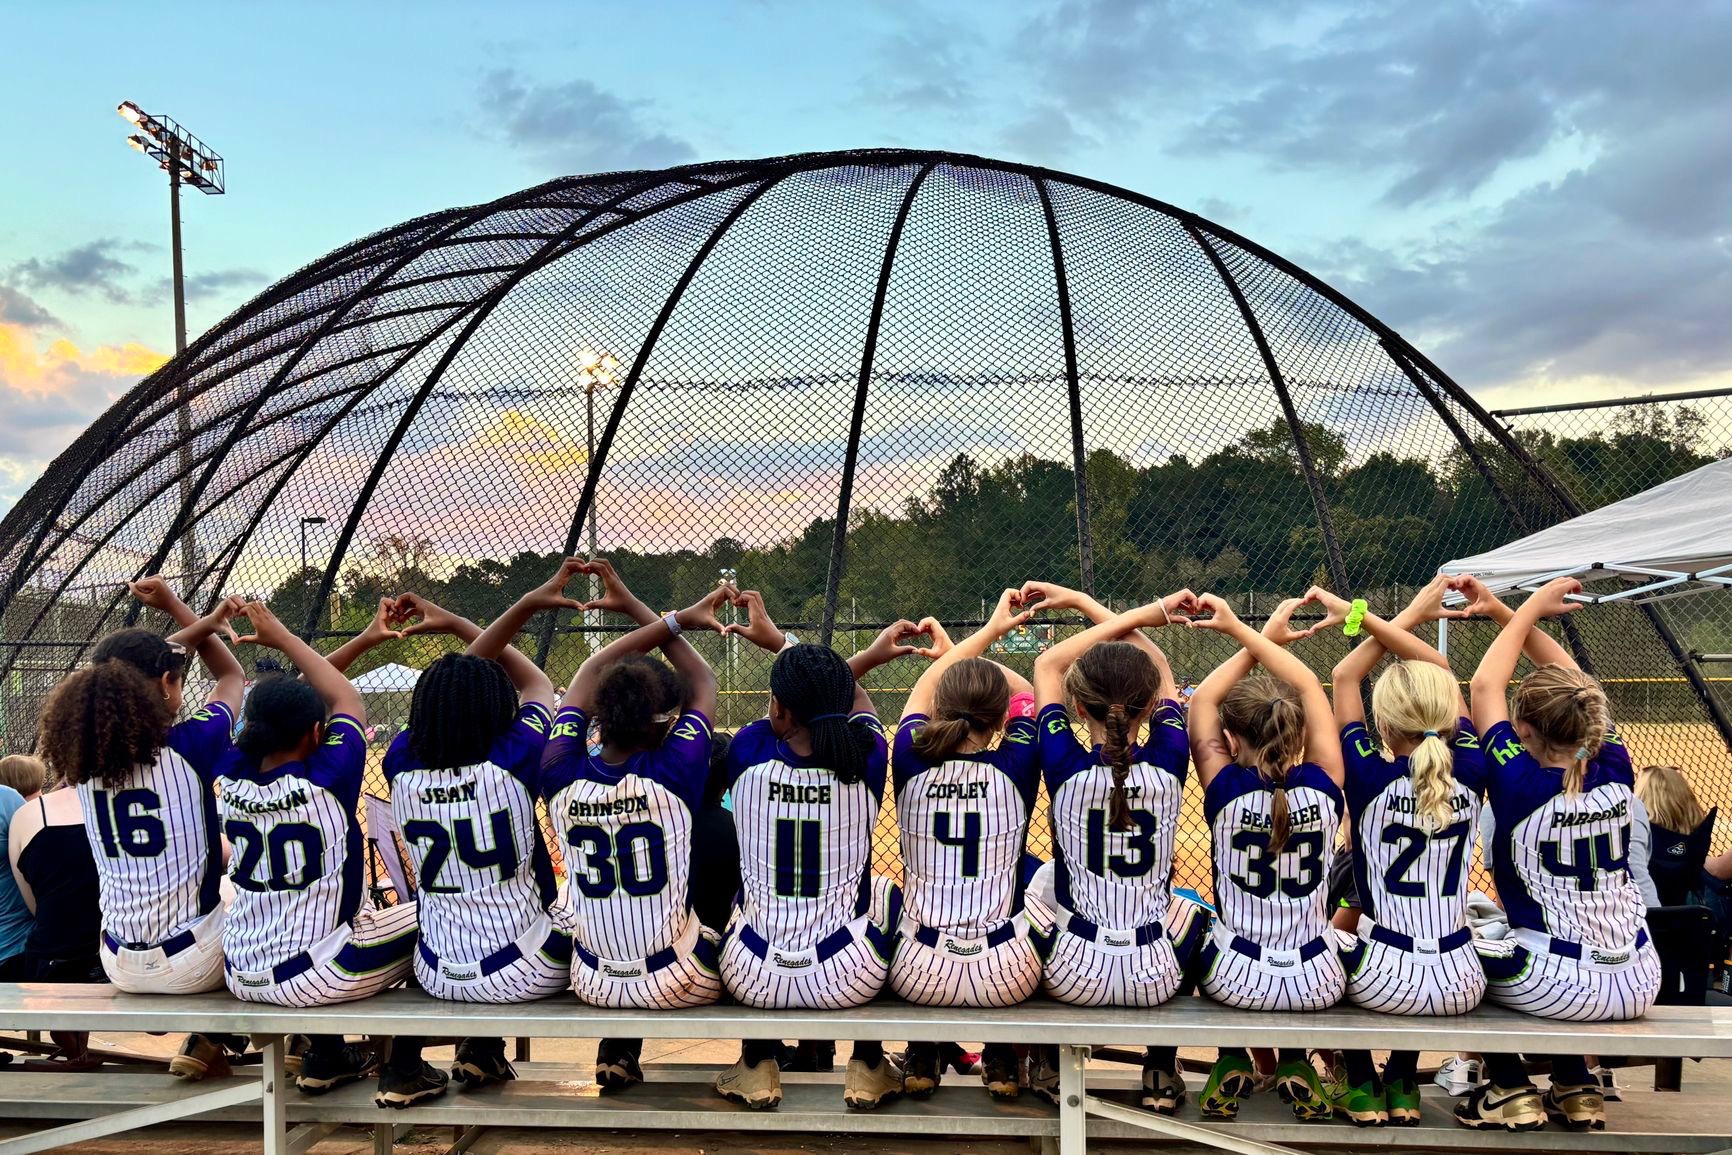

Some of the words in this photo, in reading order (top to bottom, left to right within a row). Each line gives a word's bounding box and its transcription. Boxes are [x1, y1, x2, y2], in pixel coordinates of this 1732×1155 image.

[421, 781, 476, 804] JEAN
[768, 782, 831, 804] PRICE
[926, 781, 989, 799] COPLEY
[568, 794, 648, 816] BRINSON
[1240, 804, 1321, 828] BEAHER
[1551, 799, 1627, 828] PARSONS
[92, 788, 167, 858] 16
[225, 820, 323, 892] 20
[403, 808, 518, 893] 24
[933, 811, 981, 878] 4
[1087, 808, 1157, 878] 13
[567, 820, 669, 899] 30
[775, 818, 822, 898] 11
[1230, 830, 1323, 899] 33
[1381, 818, 1470, 898] 27
[1539, 823, 1631, 891] 44
[944, 939, 983, 955] Renegades
[1589, 950, 1630, 964] Renegades
[441, 966, 477, 980] Renegades
[602, 965, 642, 978] Renegades
[773, 953, 812, 968] Renegades
[237, 975, 270, 987] Renegades
